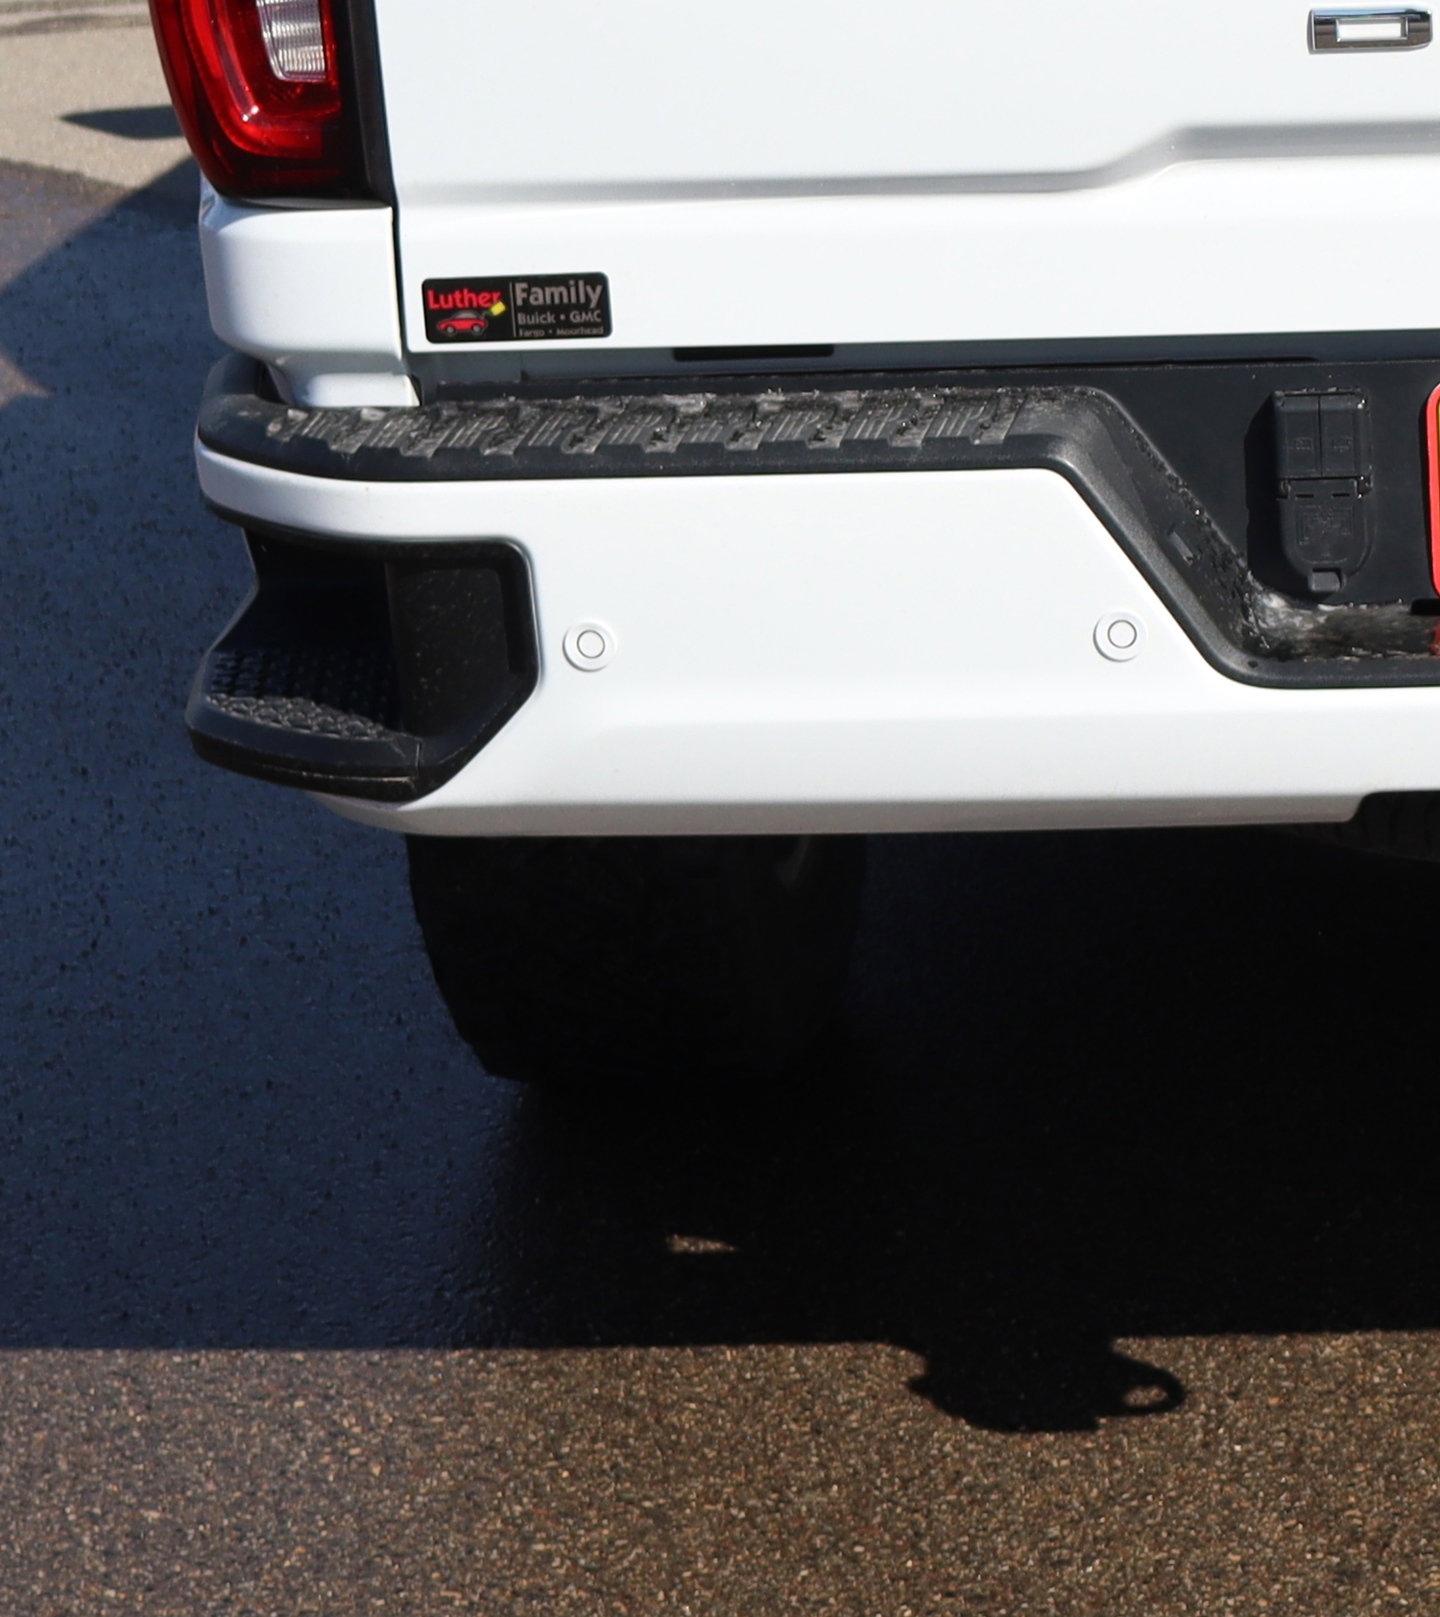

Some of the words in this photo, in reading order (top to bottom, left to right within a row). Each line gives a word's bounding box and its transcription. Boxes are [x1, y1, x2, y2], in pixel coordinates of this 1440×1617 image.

[427, 288, 502, 310] Luther
[515, 280, 603, 311] Family
[517, 311, 556, 324] Buick
[569, 310, 602, 323] GMC
